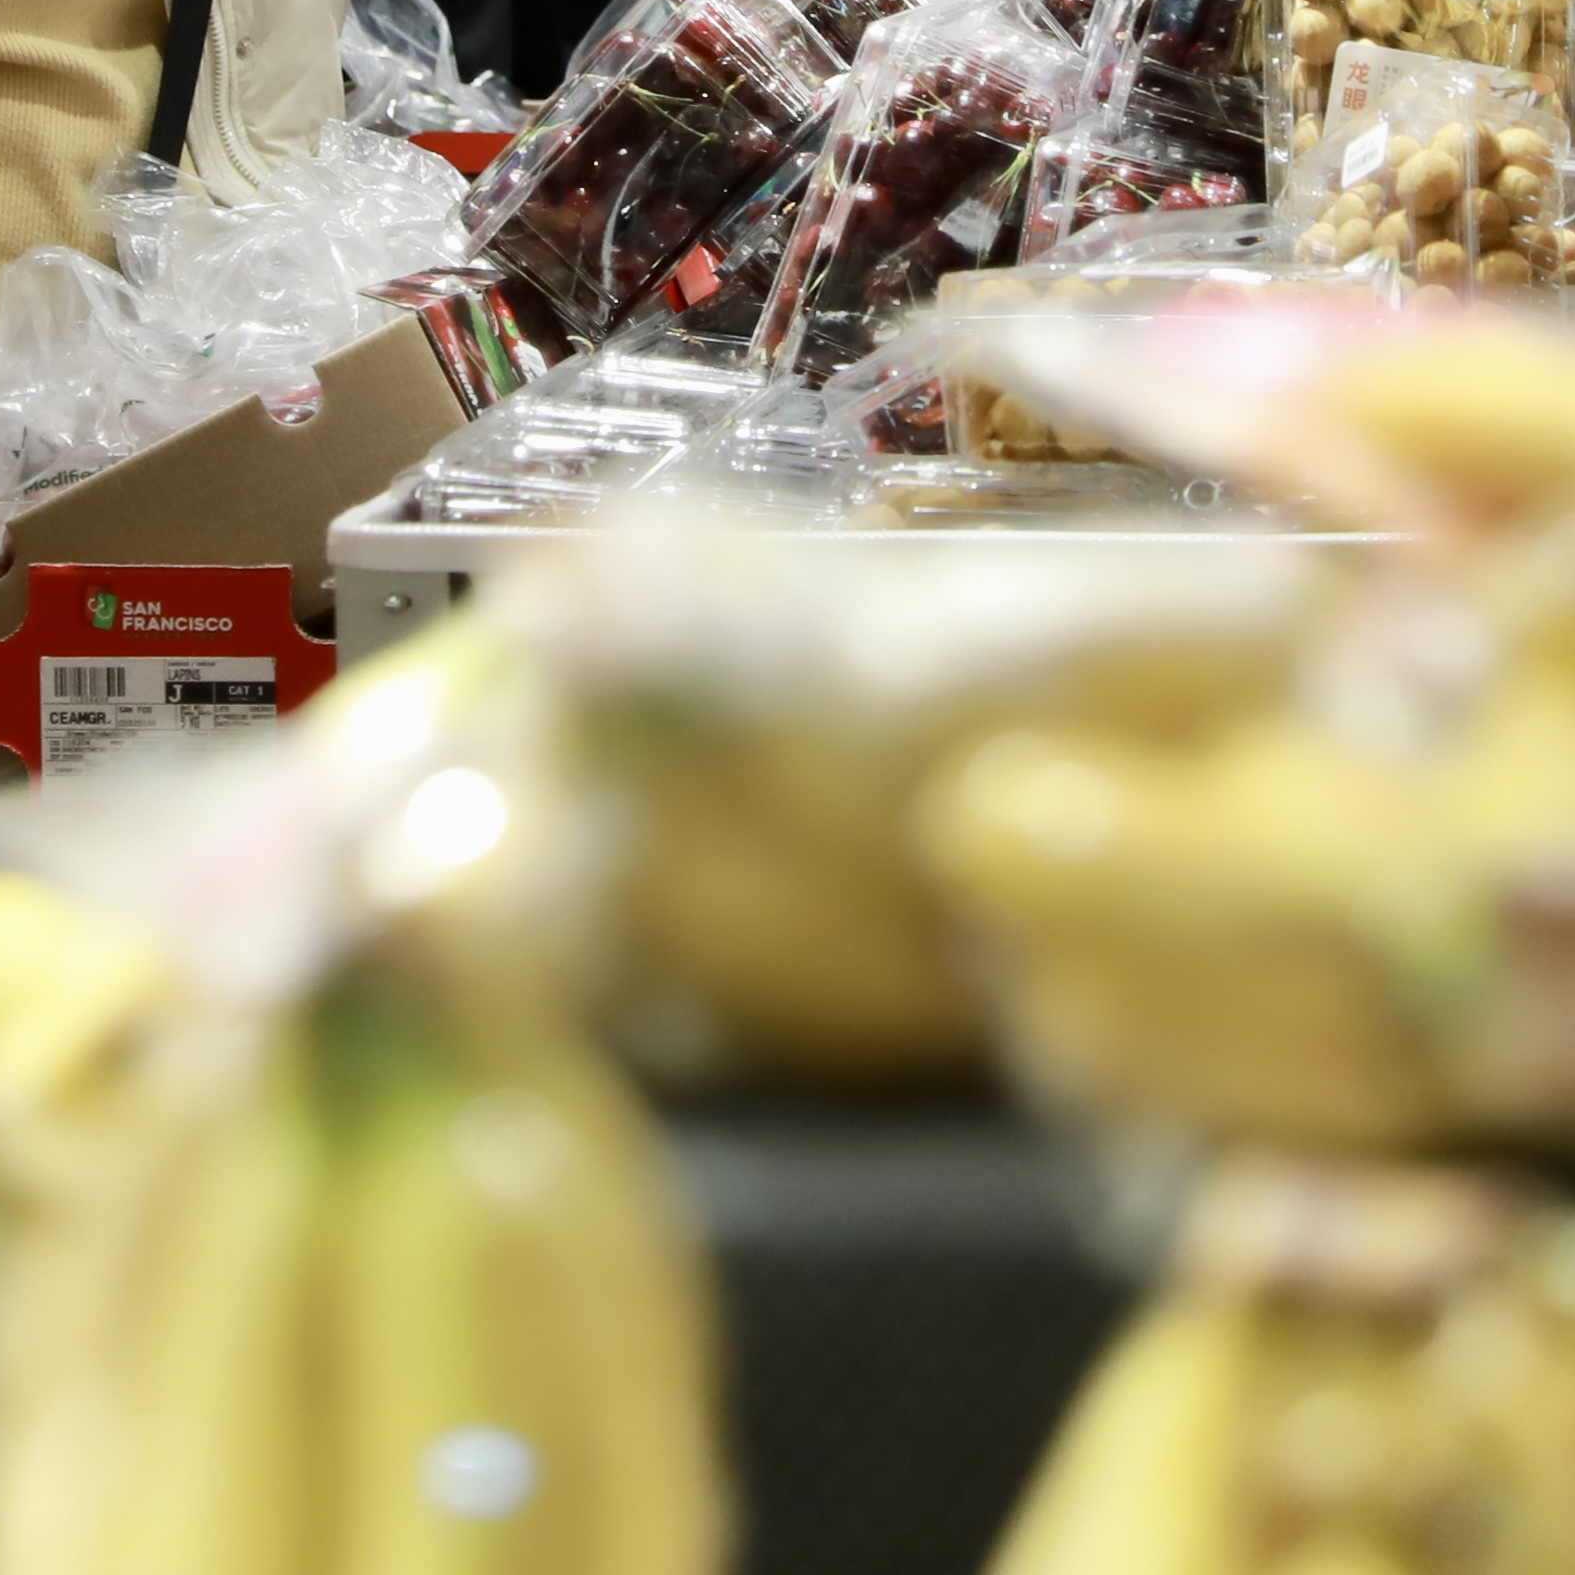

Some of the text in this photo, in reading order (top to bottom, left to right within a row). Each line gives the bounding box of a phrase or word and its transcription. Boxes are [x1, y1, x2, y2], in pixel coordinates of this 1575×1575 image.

[1341, 61, 1371, 110] 龙眼
[122, 602, 161, 615] SAN
[122, 617, 233, 631] FRANCISCO
[168, 684, 183, 703] J
[228, 685, 264, 696] CAT 1
